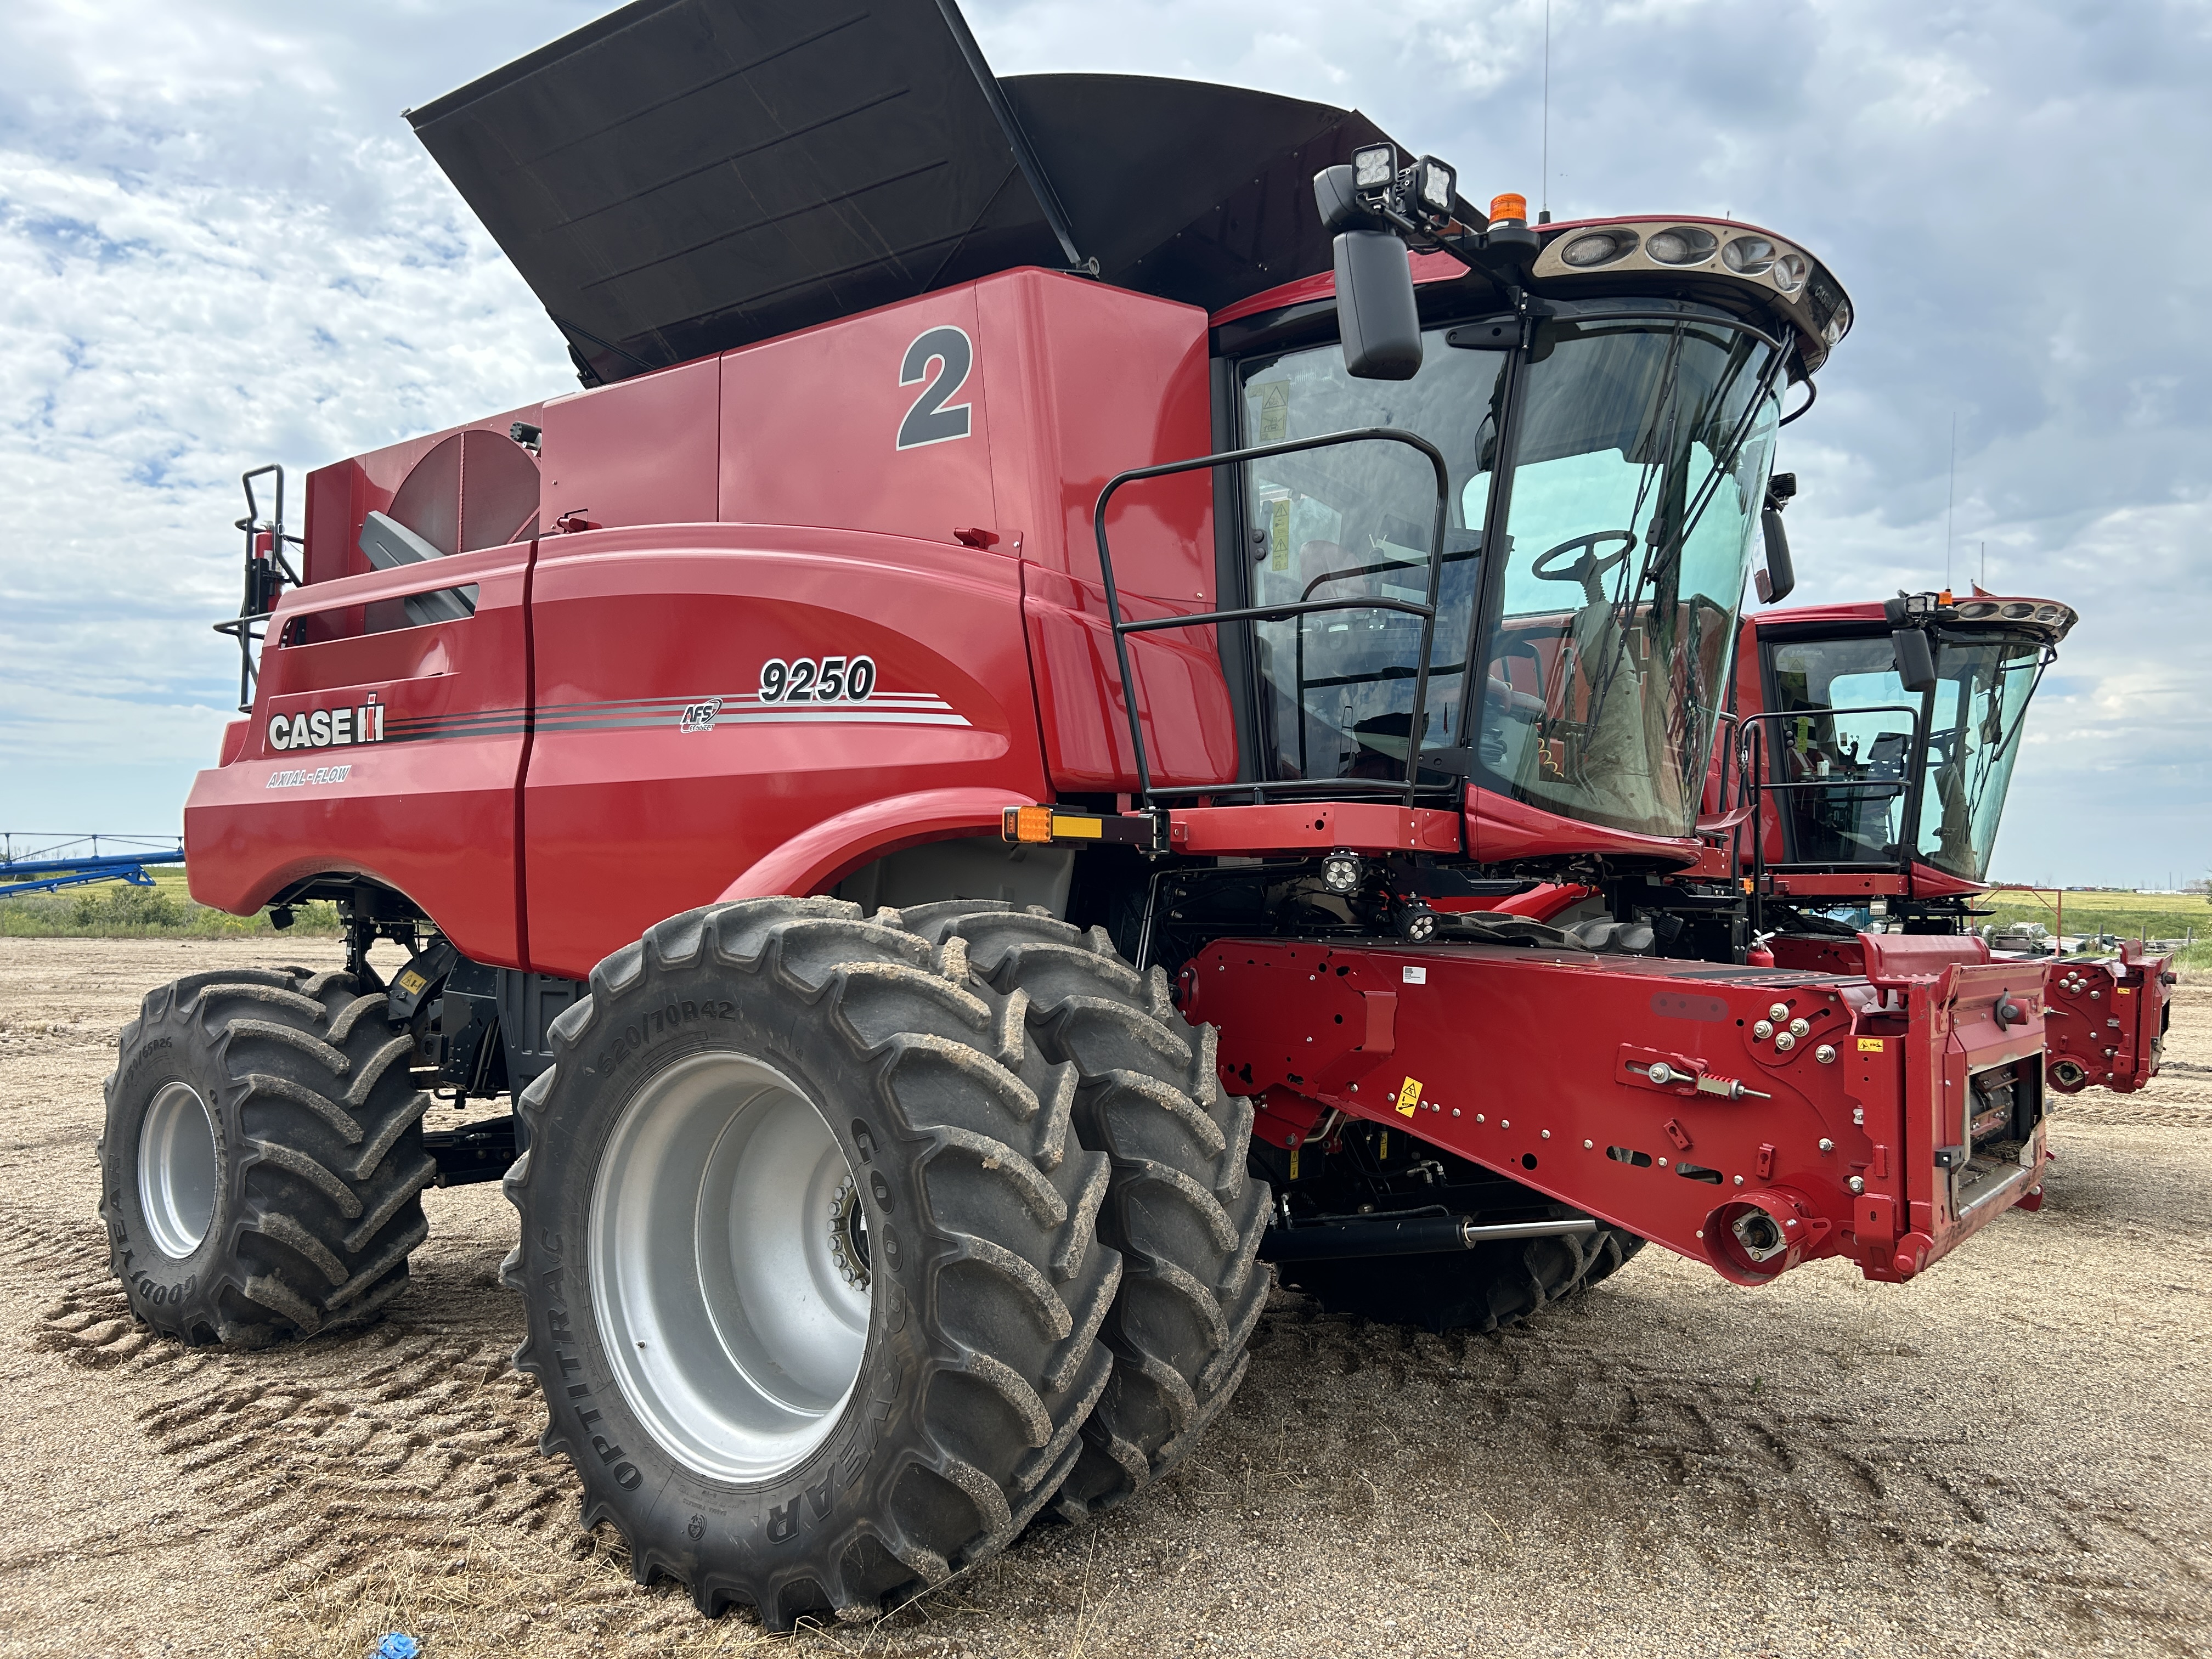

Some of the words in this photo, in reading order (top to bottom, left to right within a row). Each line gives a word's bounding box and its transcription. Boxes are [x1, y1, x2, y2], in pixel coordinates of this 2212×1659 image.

[896, 325, 973, 451] 2
[758, 654, 877, 704] 9250
[269, 708, 352, 751] CASE
[682, 706, 713, 723] AFS
[266, 765, 352, 789] AXIAL-FLOW
[598, 999, 736, 1077] 620/70R42
[541, 1227, 644, 1491] OPTITRAC
